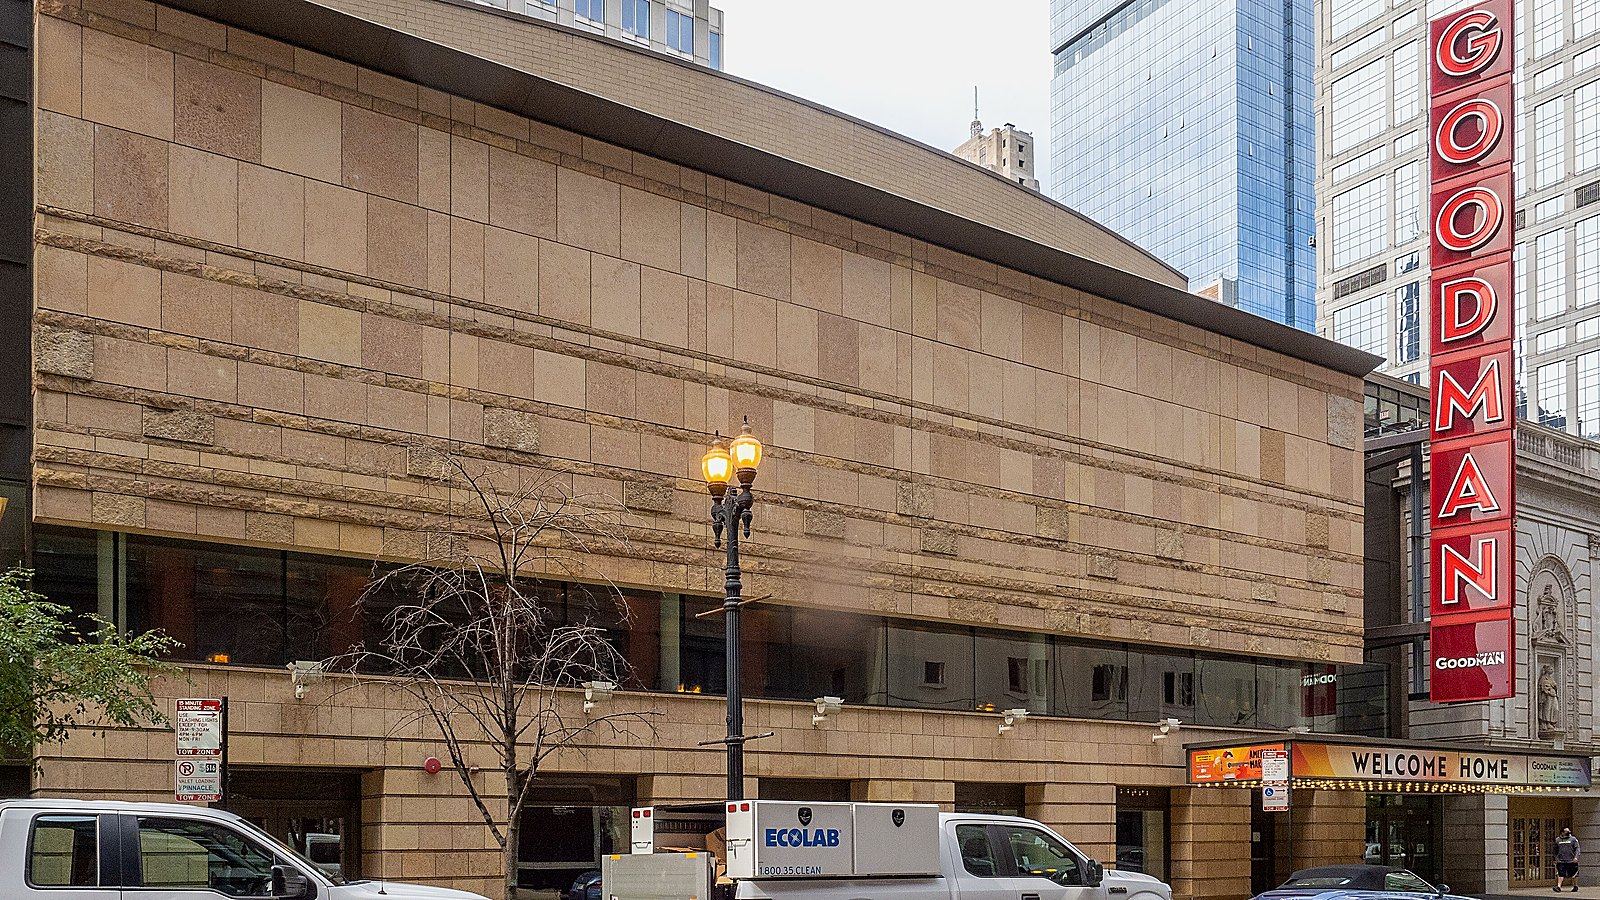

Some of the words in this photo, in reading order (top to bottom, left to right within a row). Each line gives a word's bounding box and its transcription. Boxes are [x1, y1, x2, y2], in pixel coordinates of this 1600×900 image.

[1435, 10, 1503, 606] GOODMAN
[1436, 652, 1505, 669] GOODMAN
[1352, 752, 1447, 777] WELCOME
[1460, 757, 1509, 779] HOME
[765, 828, 840, 847] ECOLAB
